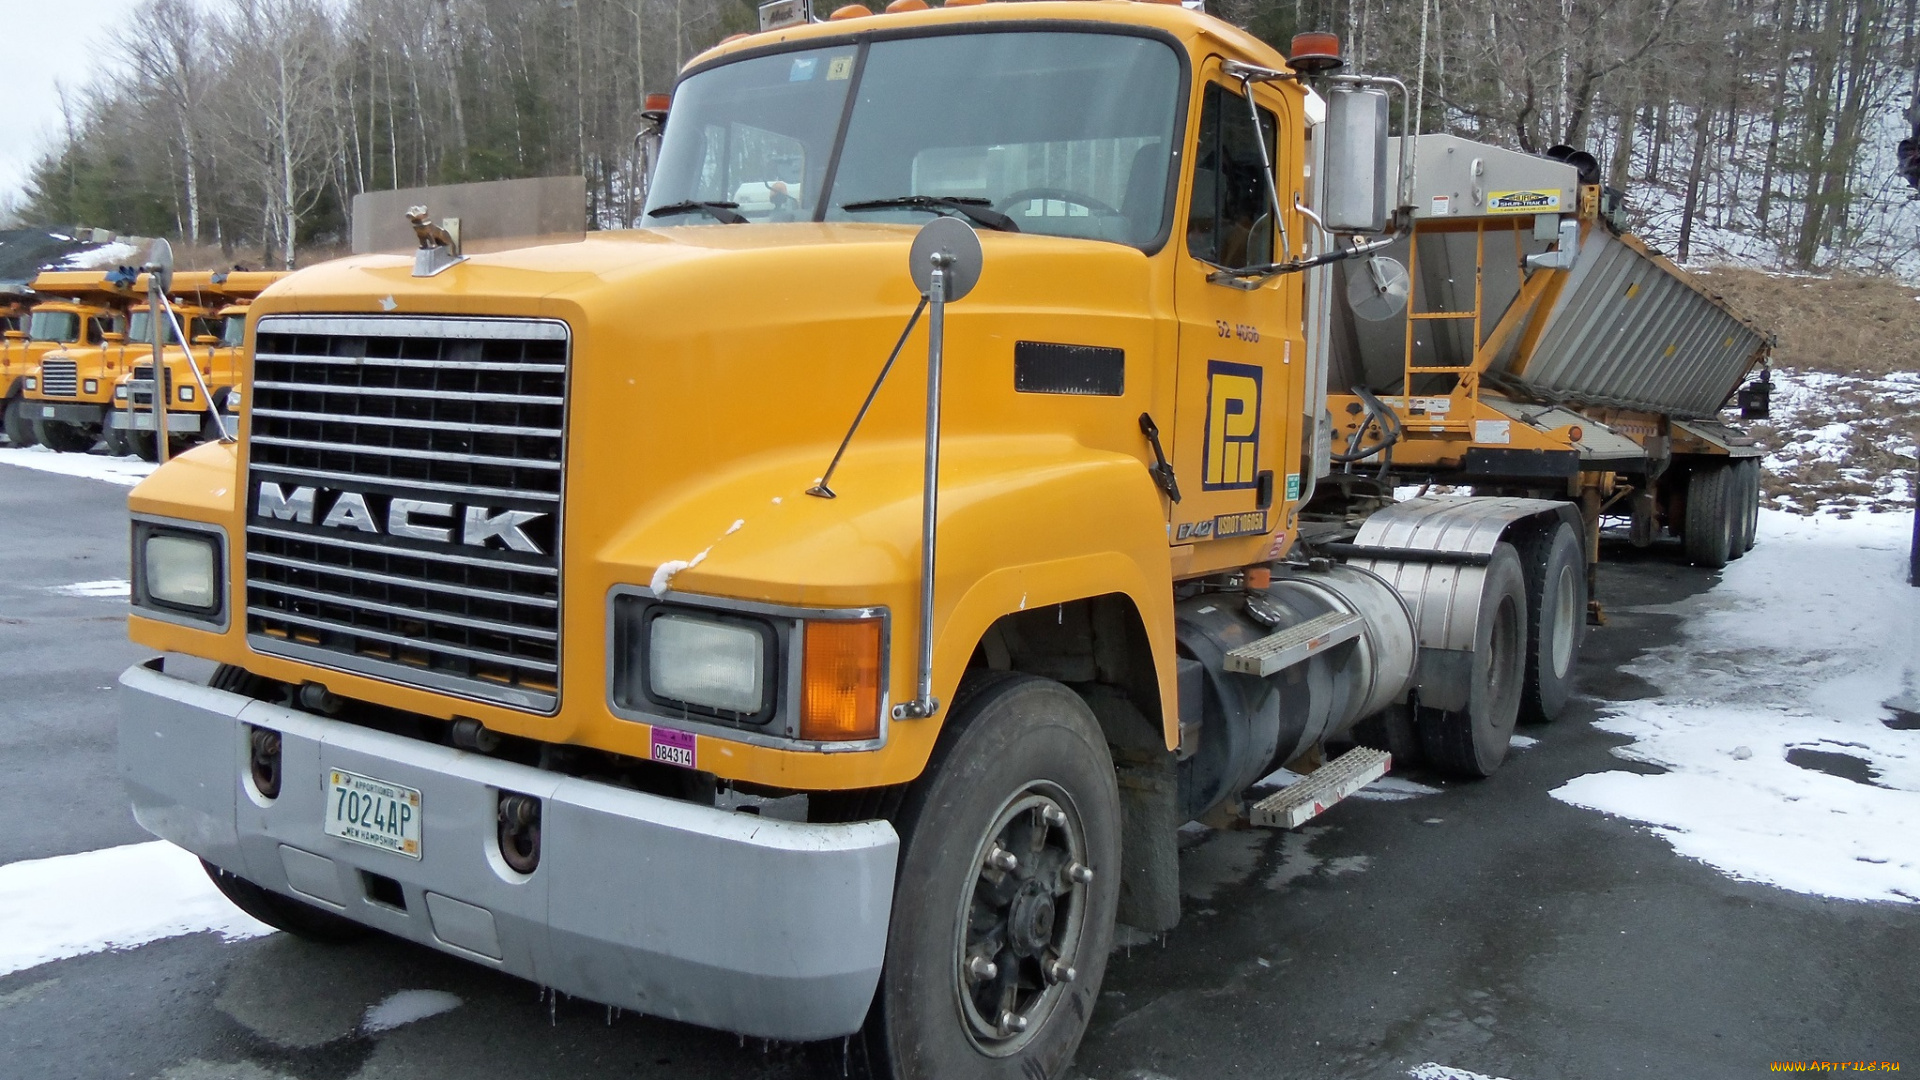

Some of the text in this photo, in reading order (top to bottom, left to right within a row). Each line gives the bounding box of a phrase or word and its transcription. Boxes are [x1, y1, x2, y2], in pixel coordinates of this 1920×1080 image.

[1216, 320, 1231, 338] 52
[258, 481, 549, 555] MACK
[1218, 515, 1240, 535] USDOT
[656, 744, 691, 765] 084314
[355, 781, 394, 798] APPORTIONED
[336, 786, 411, 837] 7024AP
[346, 826, 359, 838] NEW
[361, 831, 398, 848] HAMPSHIRE
